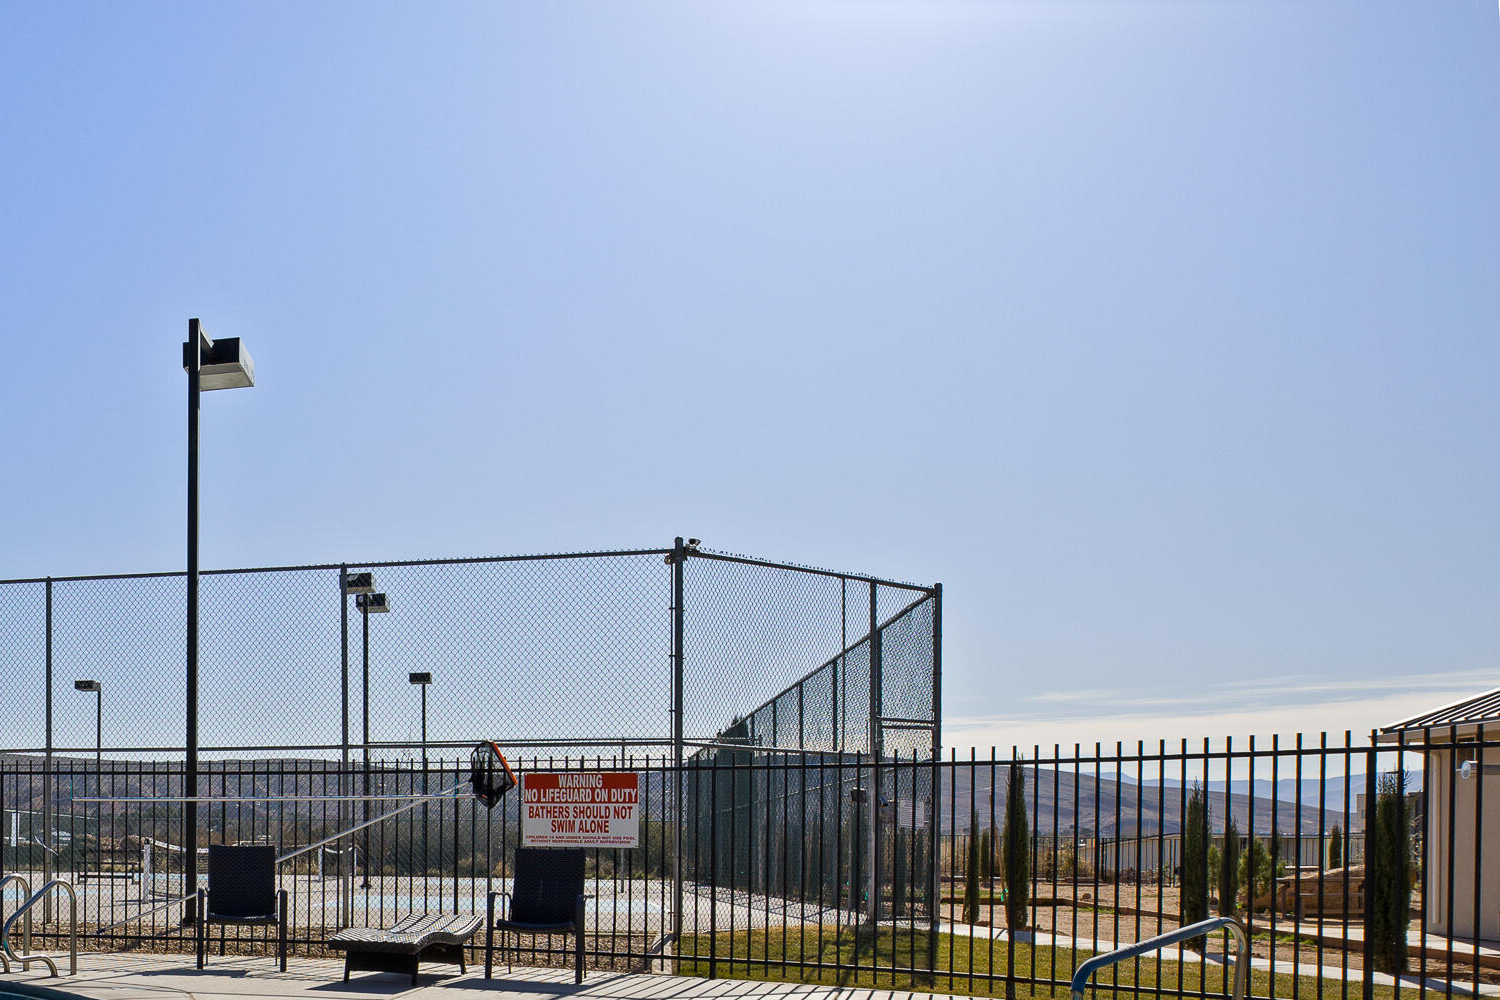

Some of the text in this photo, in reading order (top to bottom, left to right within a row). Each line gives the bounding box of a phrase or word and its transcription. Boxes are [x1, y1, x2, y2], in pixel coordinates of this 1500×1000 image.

[558, 774, 603, 788] WARNING
[525, 788, 637, 802] NO LIFEGUARD ON DUTY
[528, 806, 633, 819] BATHERS SHOULD NOT
[551, 820, 609, 833] SWIM ALONE
